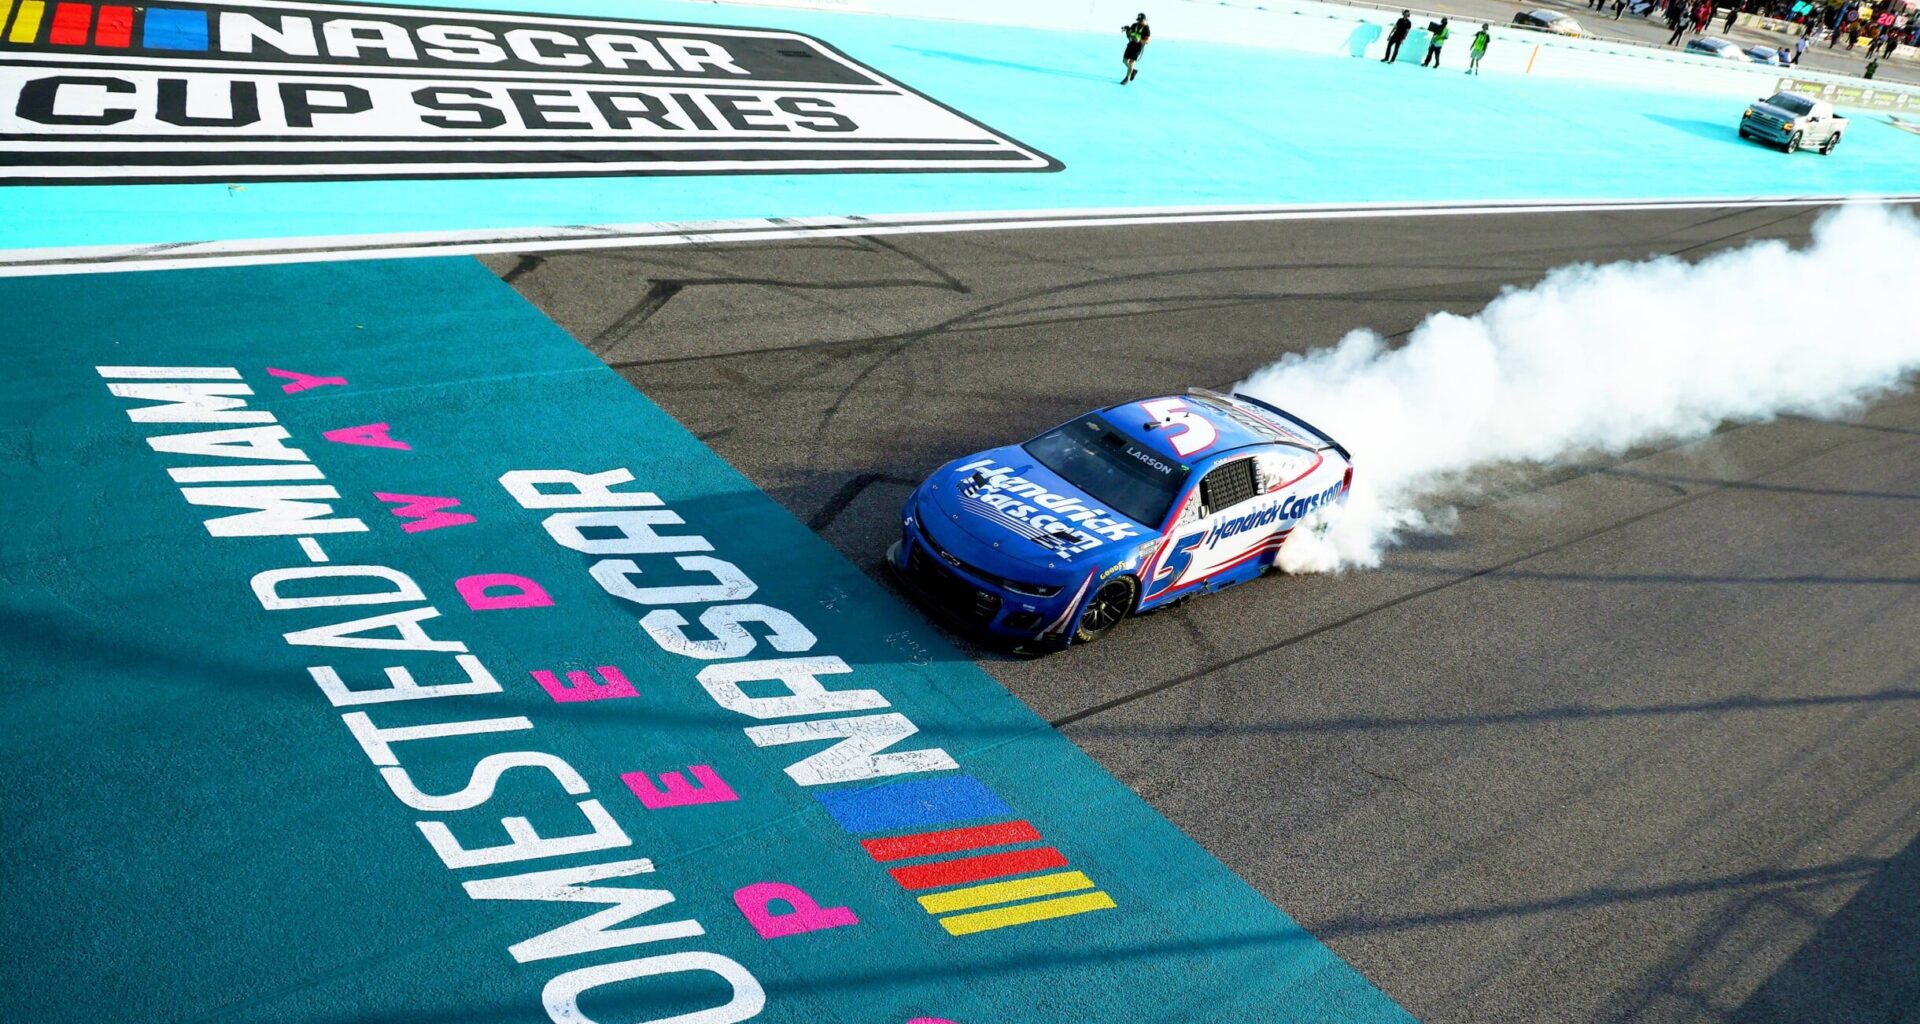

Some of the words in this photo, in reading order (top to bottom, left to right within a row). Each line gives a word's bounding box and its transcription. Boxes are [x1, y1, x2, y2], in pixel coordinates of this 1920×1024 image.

[218, 11, 751, 75] NASCAR
[15, 76, 374, 128] CUP
[411, 86, 859, 132] SERIES
[1126, 447, 1172, 475] LARSON
[1138, 397, 1218, 458] 5
[954, 459, 1140, 541] Hendrick
[964, 484, 1103, 554] Cars.com
[1100, 559, 1130, 580] GOODY
[1143, 530, 1209, 602] 5
[498, 467, 960, 787] NASCAR
[95, 366, 766, 1024] OMESTEAD-MIAMI
[266, 367, 958, 1024] PEEDWAY
